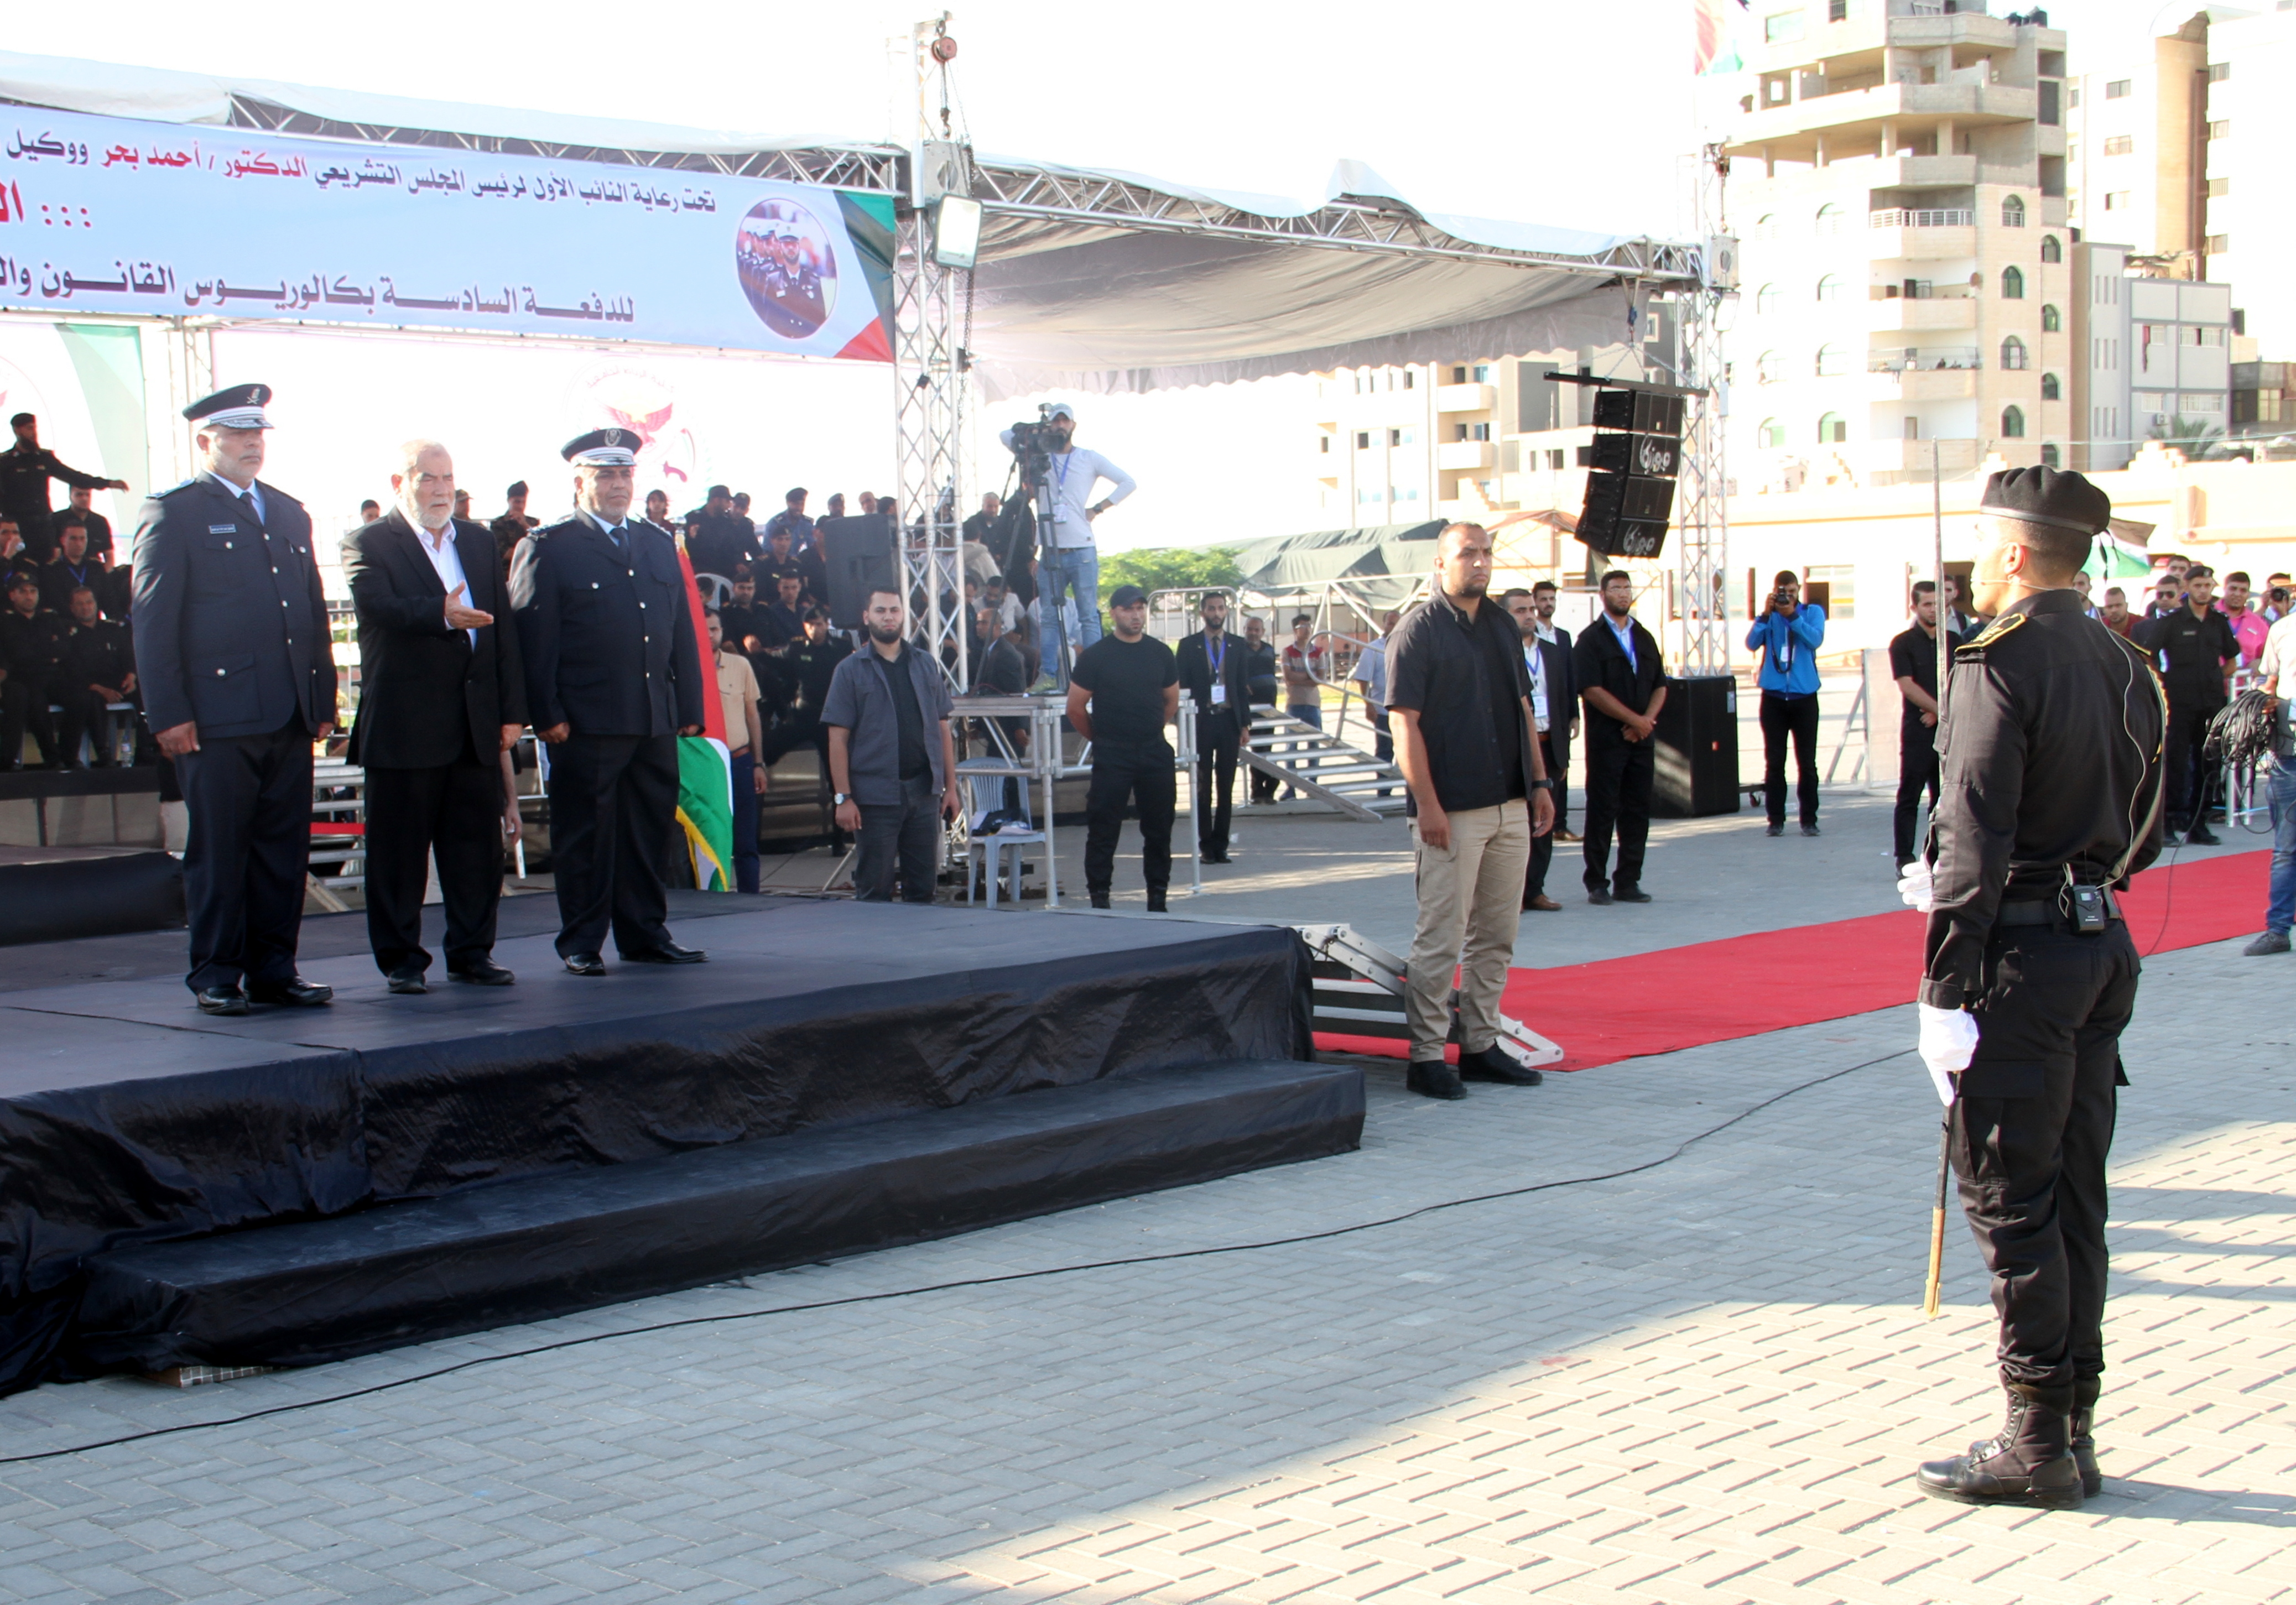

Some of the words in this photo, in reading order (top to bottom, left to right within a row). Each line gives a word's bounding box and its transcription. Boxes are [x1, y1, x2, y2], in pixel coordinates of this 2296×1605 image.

[7, 129, 88, 165] ووكيل
[101, 144, 139, 171] بحر
[147, 140, 201, 168] أحمد
[222, 150, 308, 179] الدكتور
[315, 159, 402, 189] التشريعي
[408, 168, 466, 195] المجلس
[472, 173, 527, 198] لرئيس
[534, 171, 576, 202] الأول
[580, 180, 628, 206] النائب
[632, 183, 679, 212] رعاية
[683, 189, 716, 212] تحت
[41, 260, 175, 299] القانون
[184, 274, 376, 315] بكالوريوس
[379, 277, 517, 315] السادسة
[522, 286, 634, 322] للدفعة
